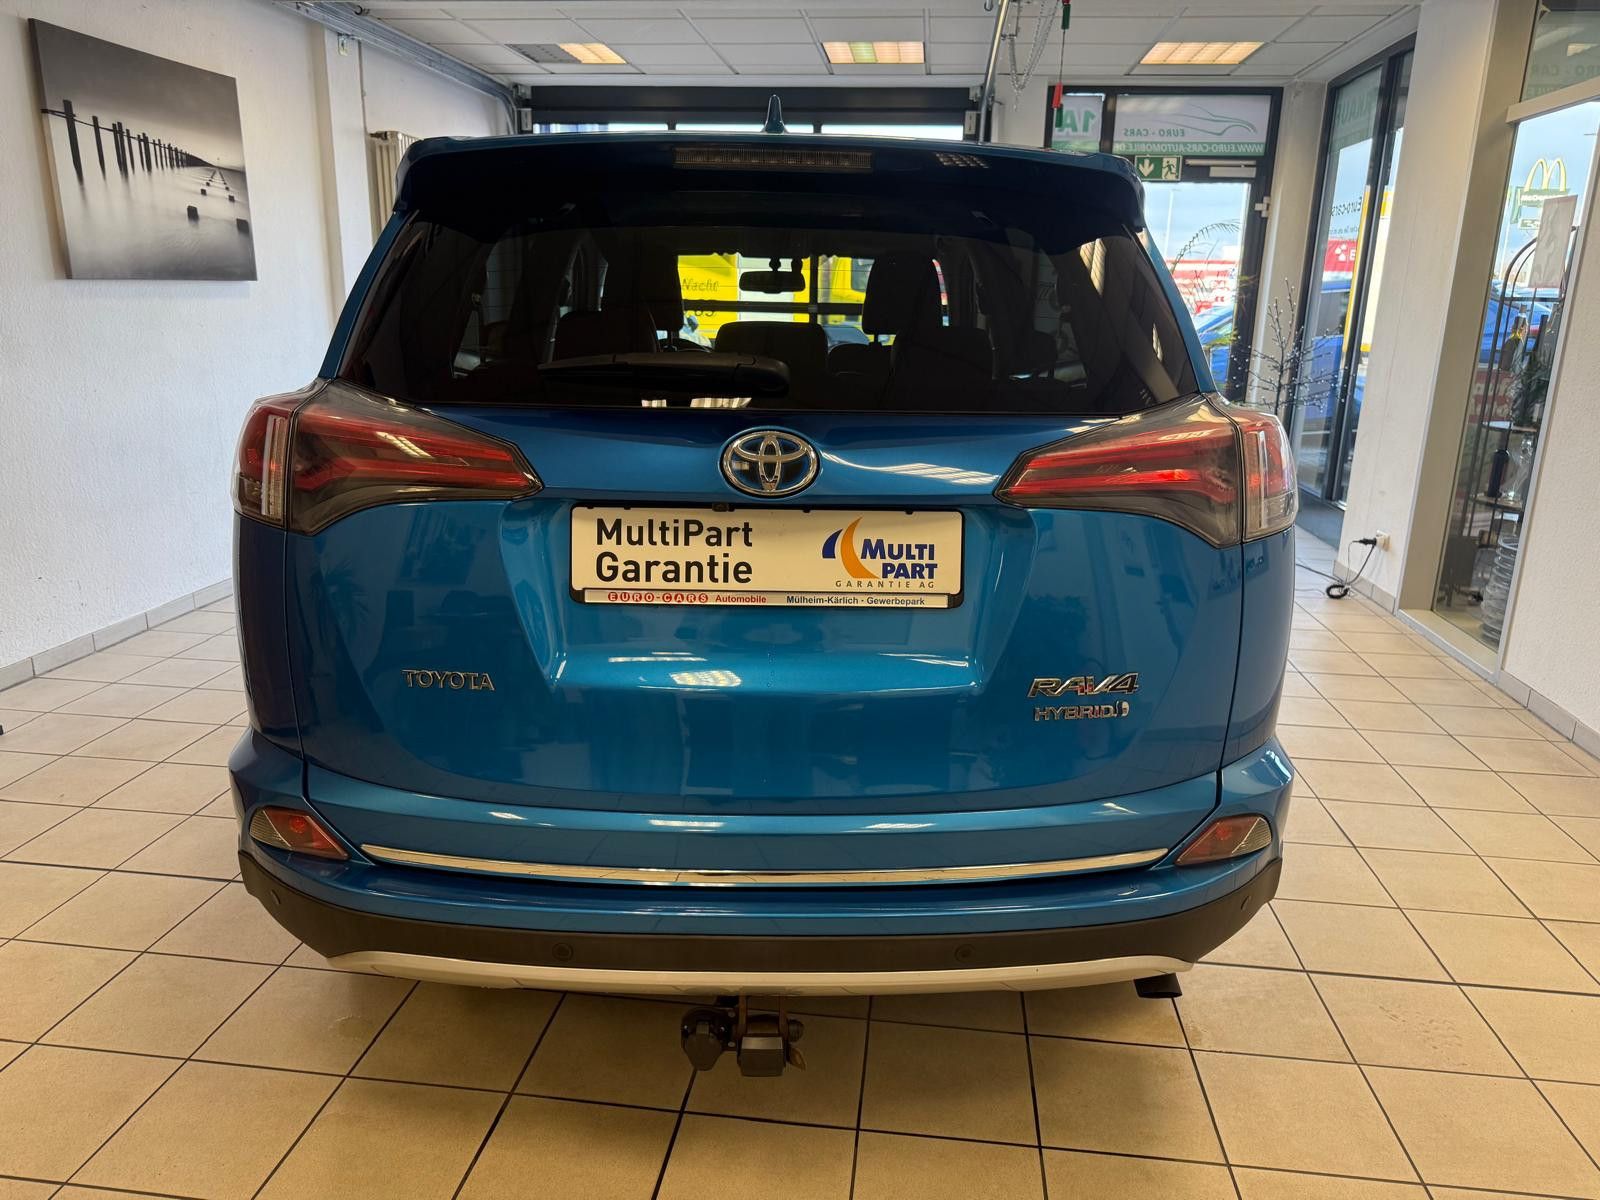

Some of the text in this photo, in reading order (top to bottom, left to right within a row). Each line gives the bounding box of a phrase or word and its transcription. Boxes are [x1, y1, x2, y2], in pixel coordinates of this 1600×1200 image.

[596, 518, 753, 547] MultiPart
[596, 551, 753, 583] Garantie
[882, 563, 938, 579] PART
[835, 580, 934, 589] GARANTIE AG
[608, 591, 767, 604] EURO-CARS Automobile
[786, 595, 925, 606] Mülheim-Kärlich Gewerbepark
[402, 669, 496, 691] TOYOTA
[1027, 672, 1139, 698] RAV4
[1034, 704, 1117, 721] HYBRID
